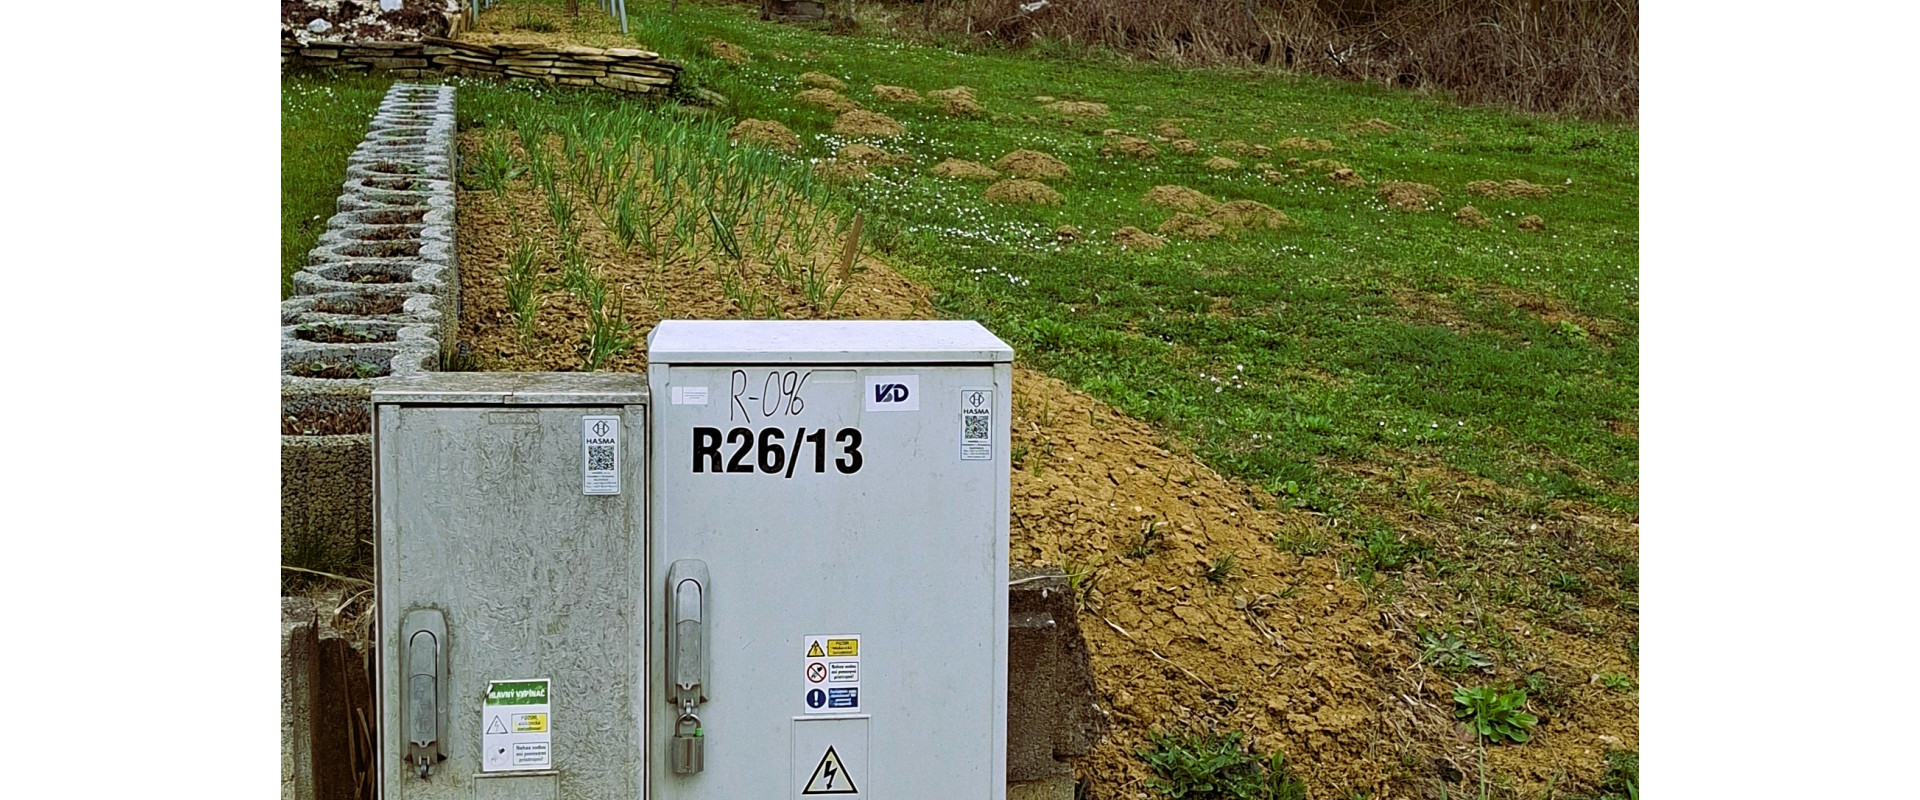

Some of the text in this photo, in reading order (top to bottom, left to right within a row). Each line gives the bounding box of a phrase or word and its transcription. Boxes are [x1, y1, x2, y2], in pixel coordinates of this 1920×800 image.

[731, 369, 811, 424] R-096
[692, 427, 863, 479] R26/13
[489, 688, 545, 698] HLAVNÝ VYPÍNAČ
